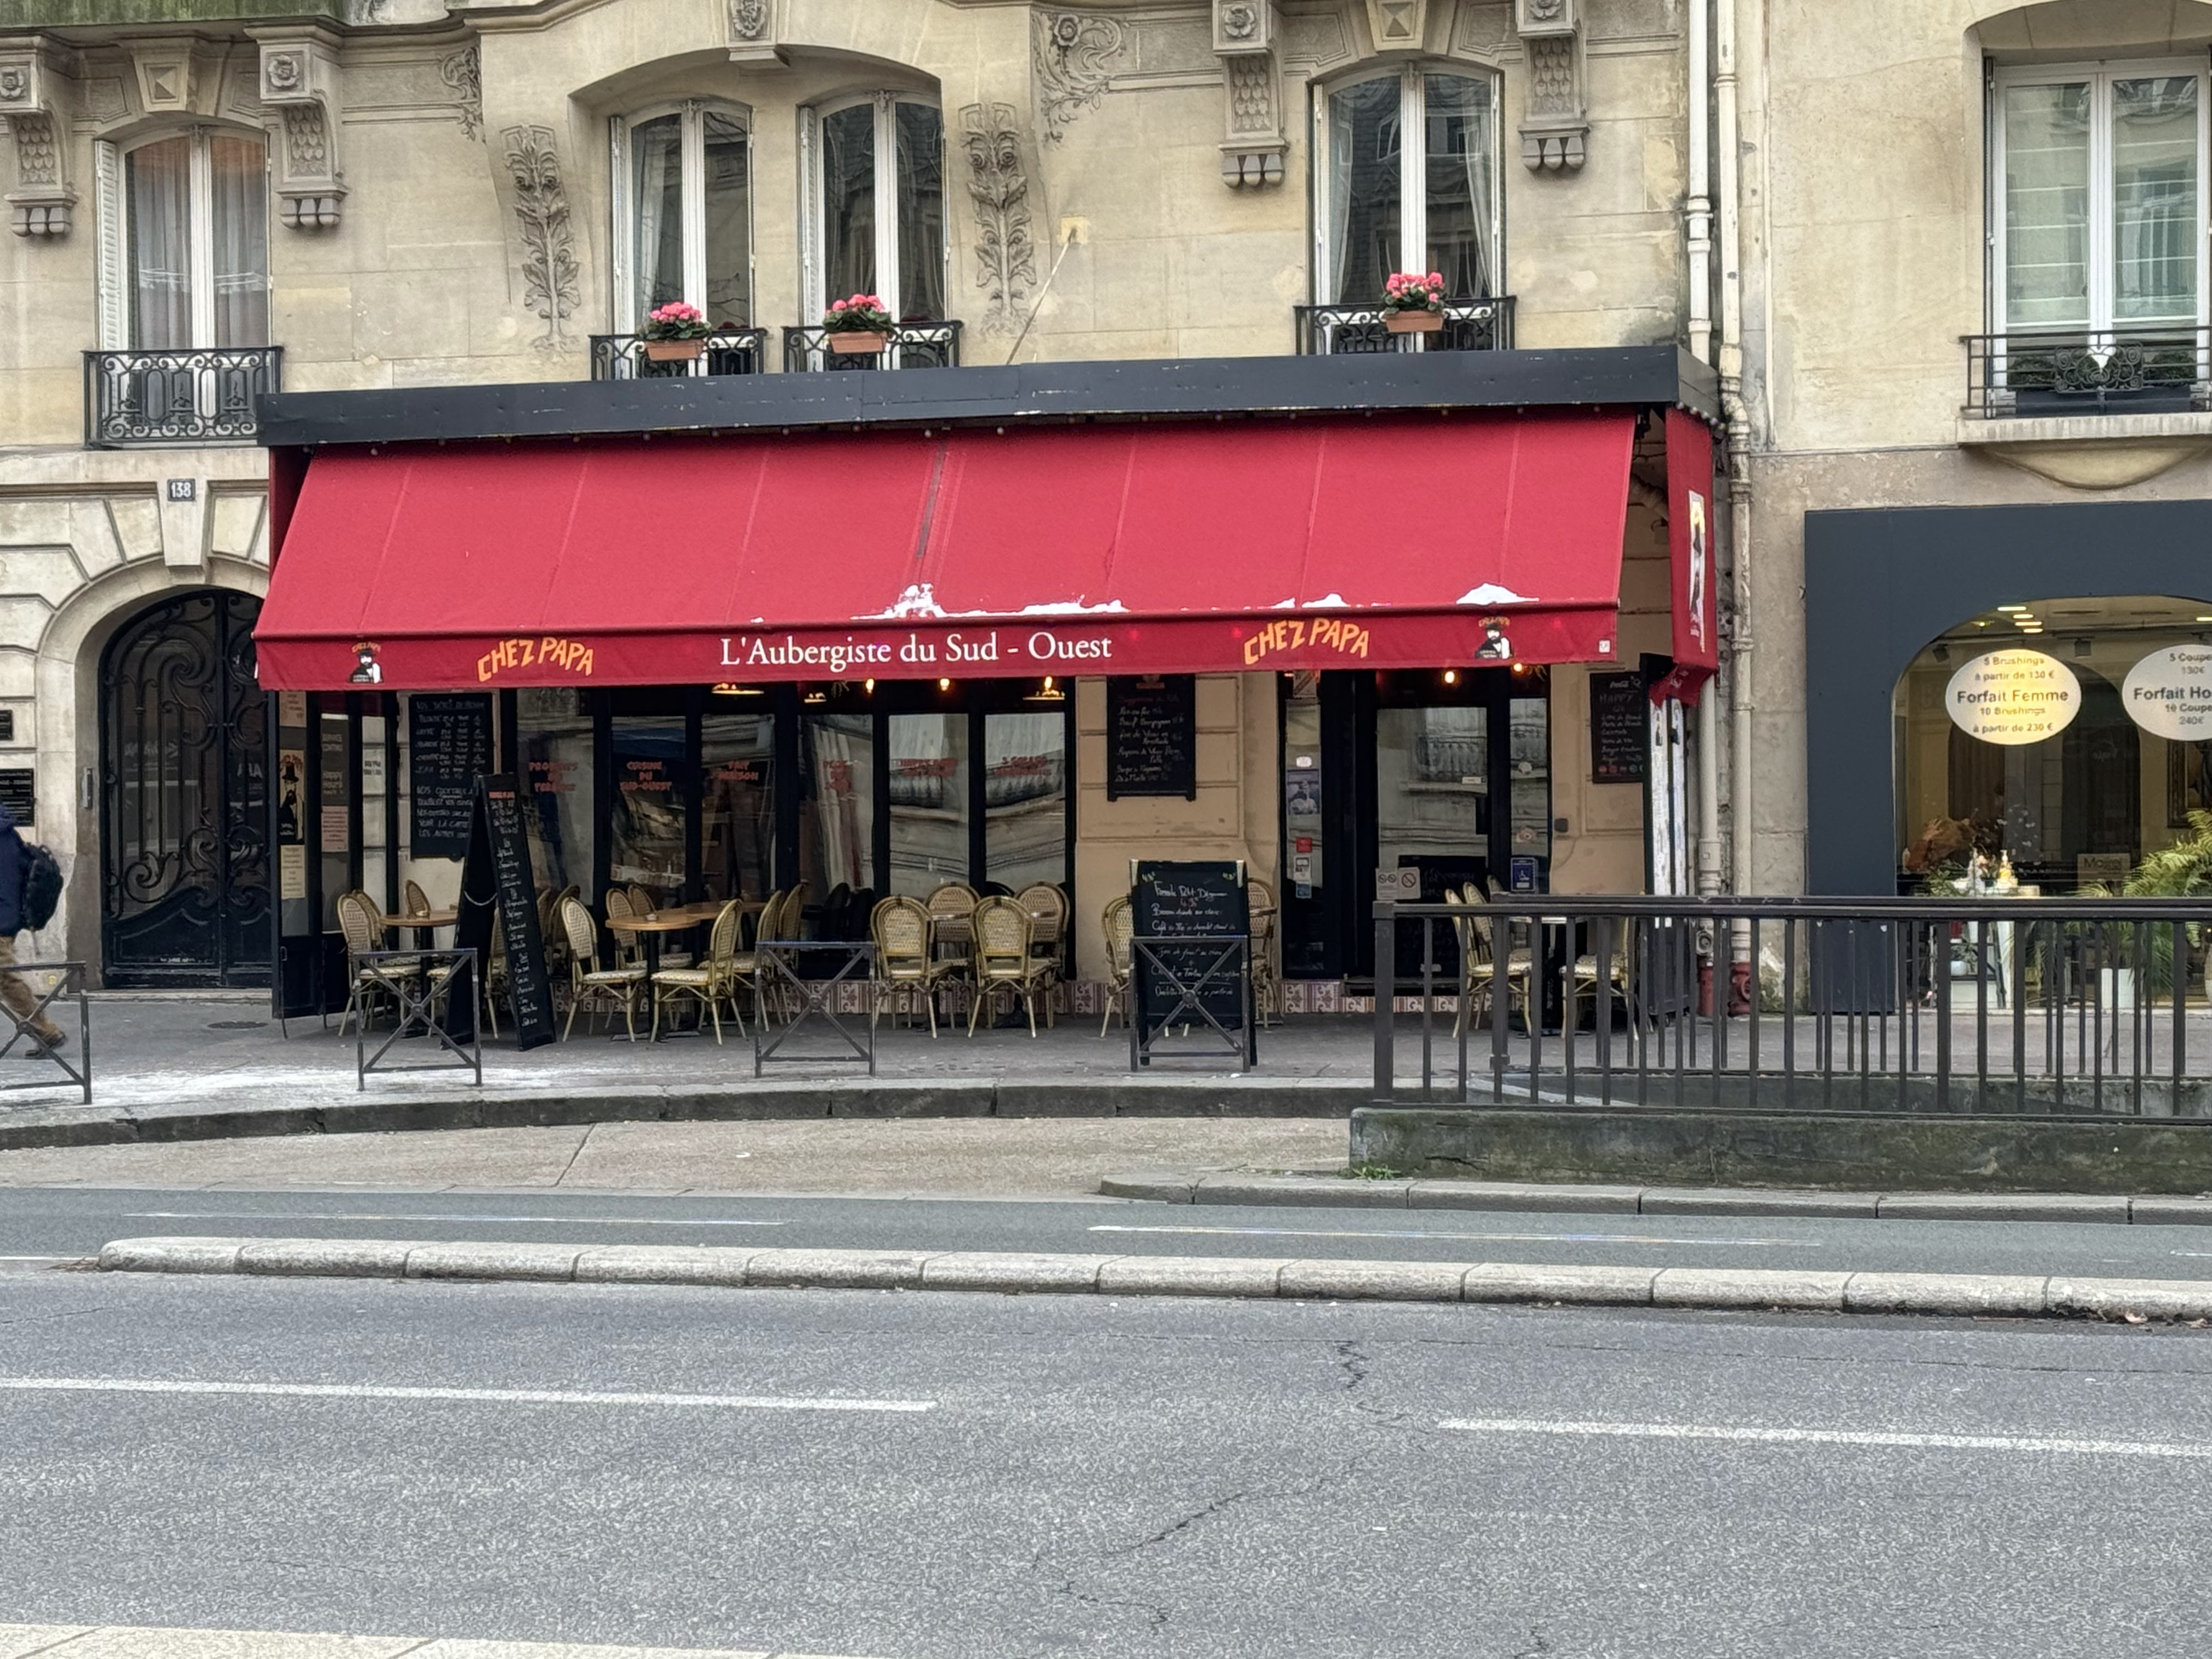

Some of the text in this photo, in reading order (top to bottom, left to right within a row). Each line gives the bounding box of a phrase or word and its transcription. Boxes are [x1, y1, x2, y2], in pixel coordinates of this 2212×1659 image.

[171, 482, 191, 498] 138
[1244, 617, 1369, 665] CHEZ PAPA
[720, 635, 891, 673] L'Aubergiste
[900, 633, 937, 662] du
[945, 631, 1000, 662] Sud
[1028, 631, 1112, 660] Ouest
[2169, 653, 2176, 662] 5
[477, 636, 594, 682] CHEZ PAPA
[1993, 657, 2045, 667] Brushings
[1983, 672, 2010, 681] partir
[2013, 671, 2025, 679] de
[2029, 670, 2046, 679] 130
[1957, 690, 2069, 704] Forfait Femme
[2133, 686, 2186, 701] Forfait
[1980, 707, 2046, 716] 10 Brushings
[2165, 703, 2177, 713] 10
[2179, 716, 2205, 725] 240€
[1982, 724, 2009, 734] partir
[2012, 723, 2024, 732] de
[2027, 723, 2045, 732] 230
